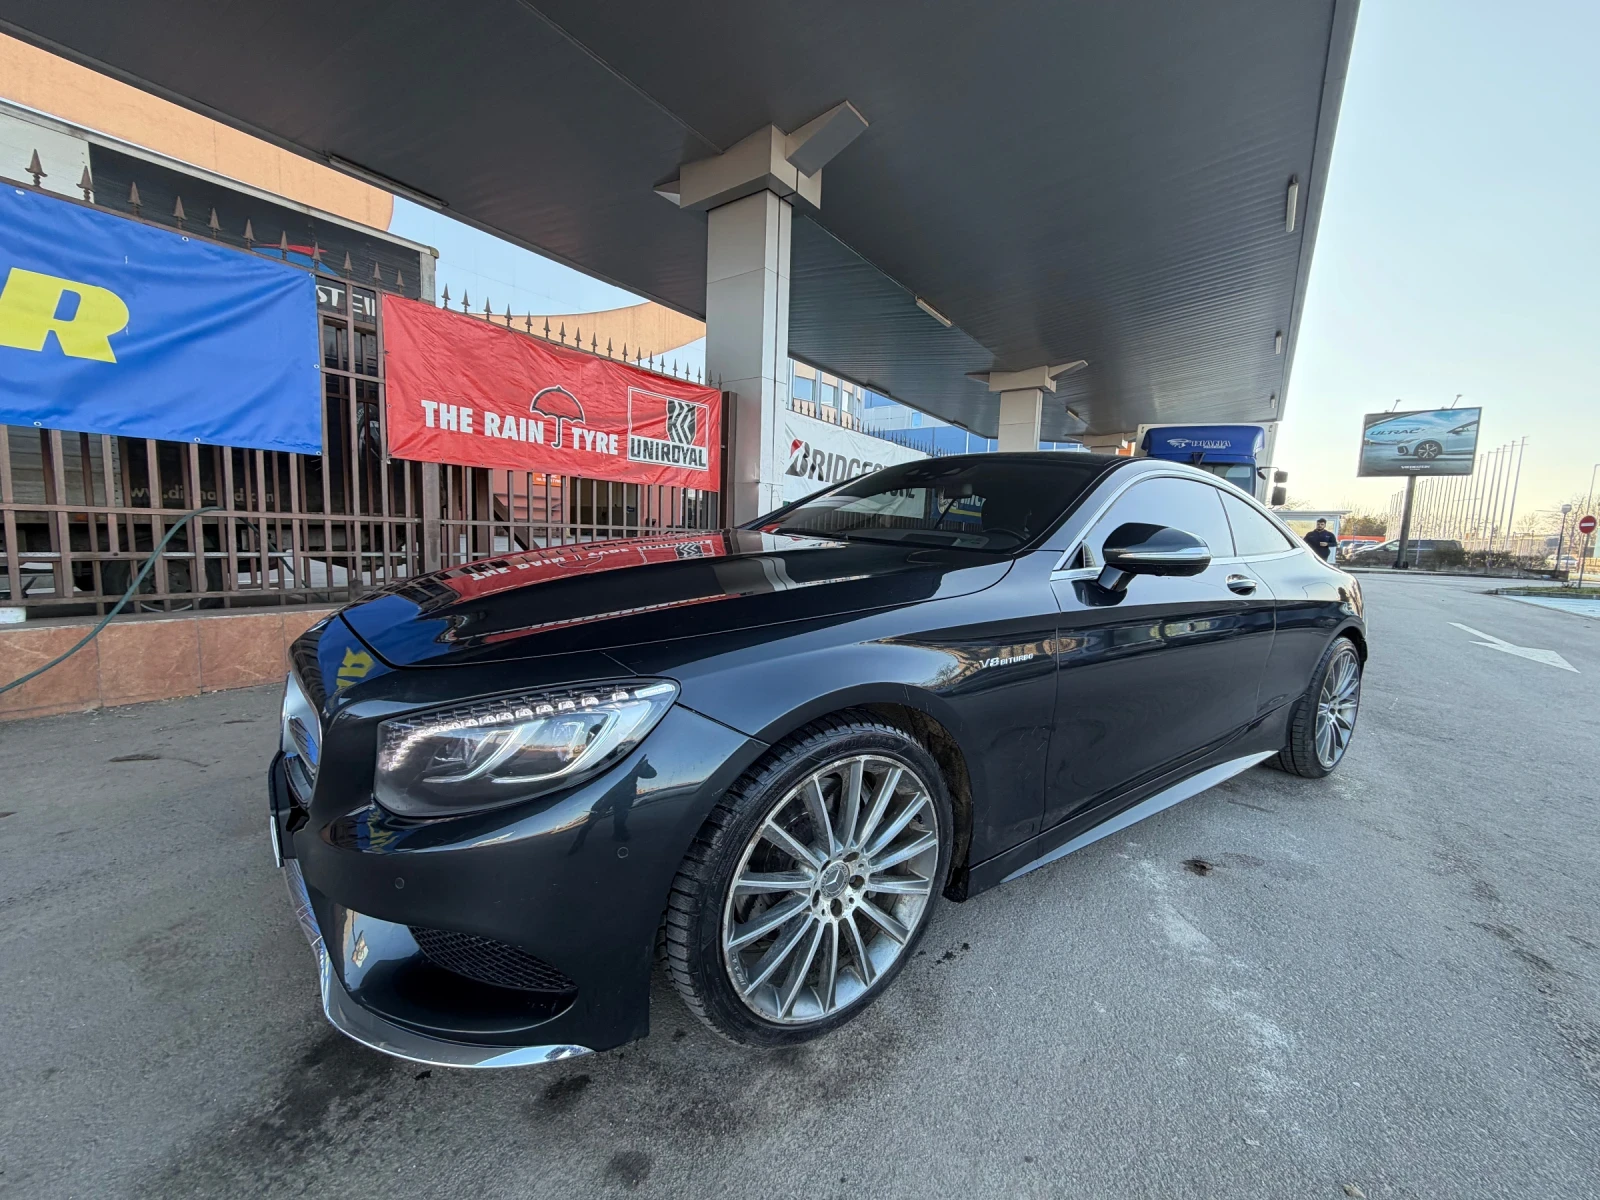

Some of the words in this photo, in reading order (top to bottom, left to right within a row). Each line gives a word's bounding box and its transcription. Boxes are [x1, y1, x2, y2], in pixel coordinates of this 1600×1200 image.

[421, 400, 473, 434] THE
[484, 411, 545, 445] RAIN
[571, 427, 619, 456] TYRE
[630, 437, 708, 468] UNIROYAL
[979, 657, 1000, 669] V8
[1000, 653, 1034, 666] BITURBO
